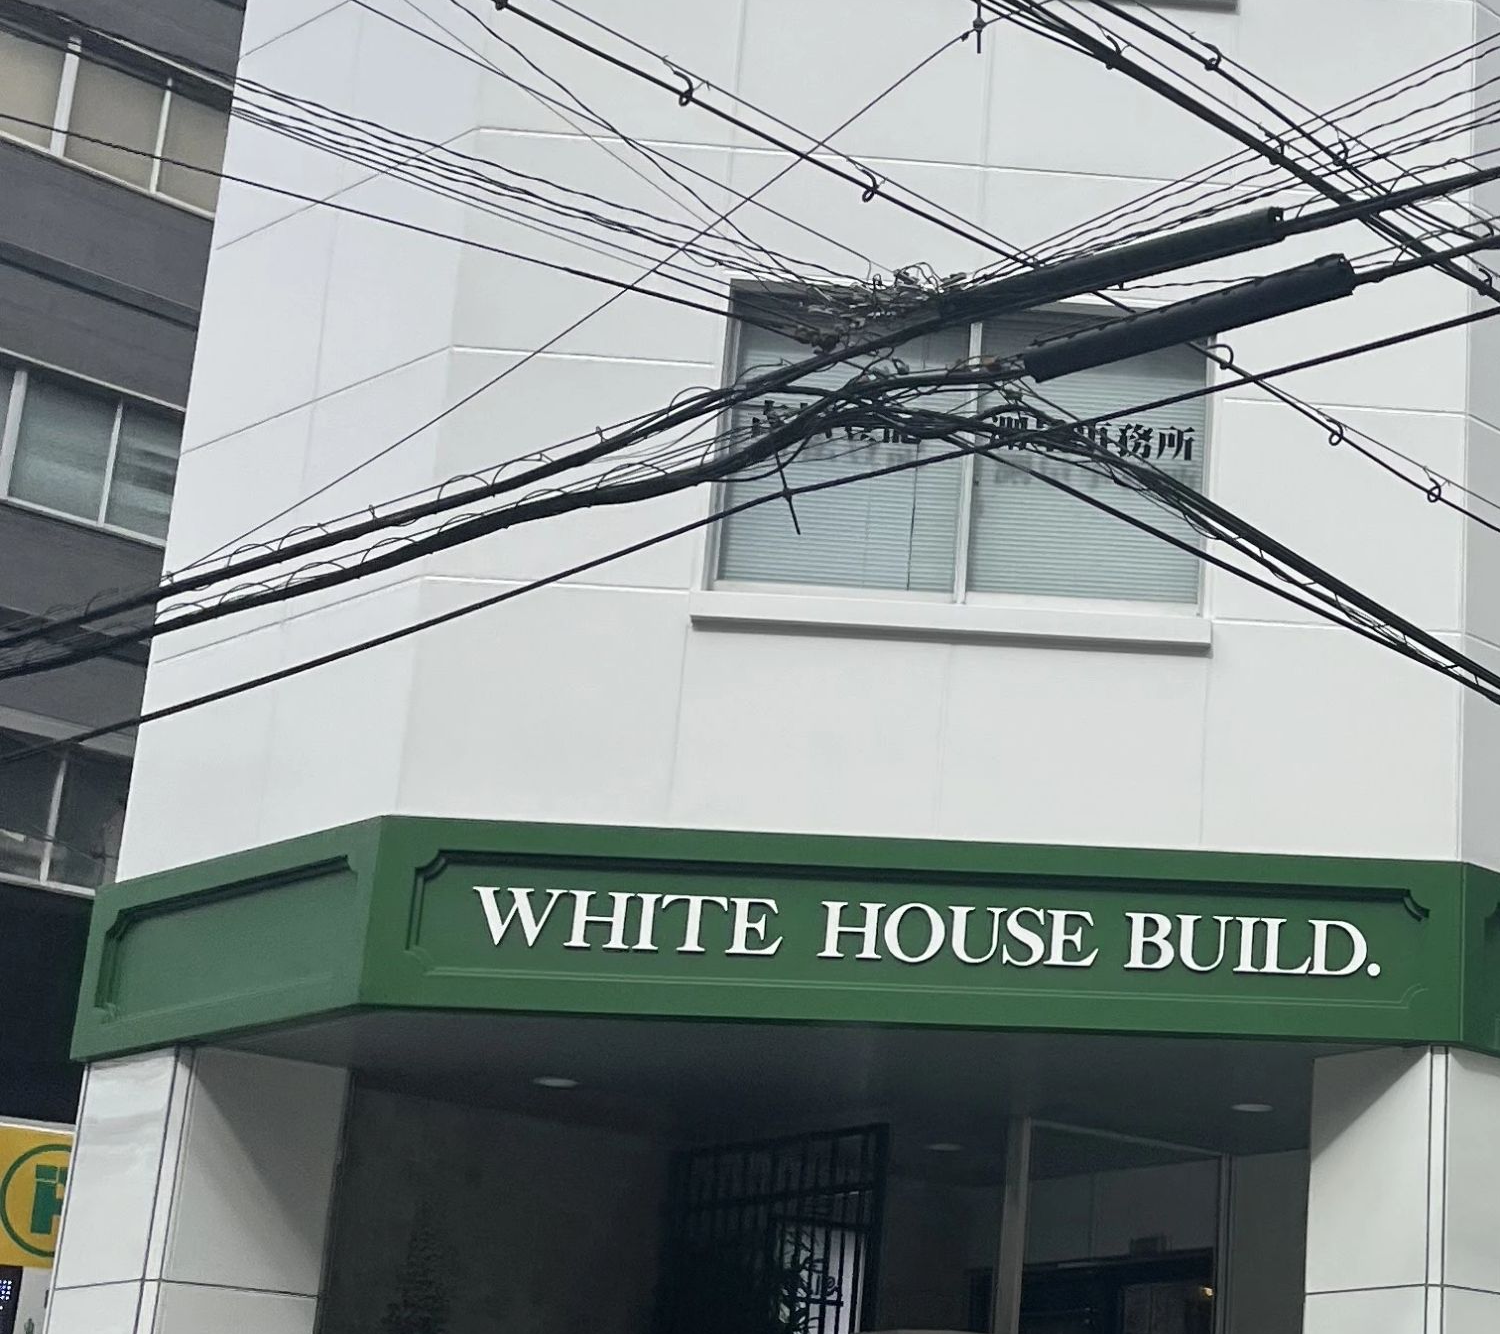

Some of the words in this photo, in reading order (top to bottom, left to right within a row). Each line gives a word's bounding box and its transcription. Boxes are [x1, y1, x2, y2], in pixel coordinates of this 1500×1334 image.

[473, 884, 783, 957] WHITE
[816, 900, 1100, 969] HOUSE
[1123, 911, 1382, 978] BUILD.
